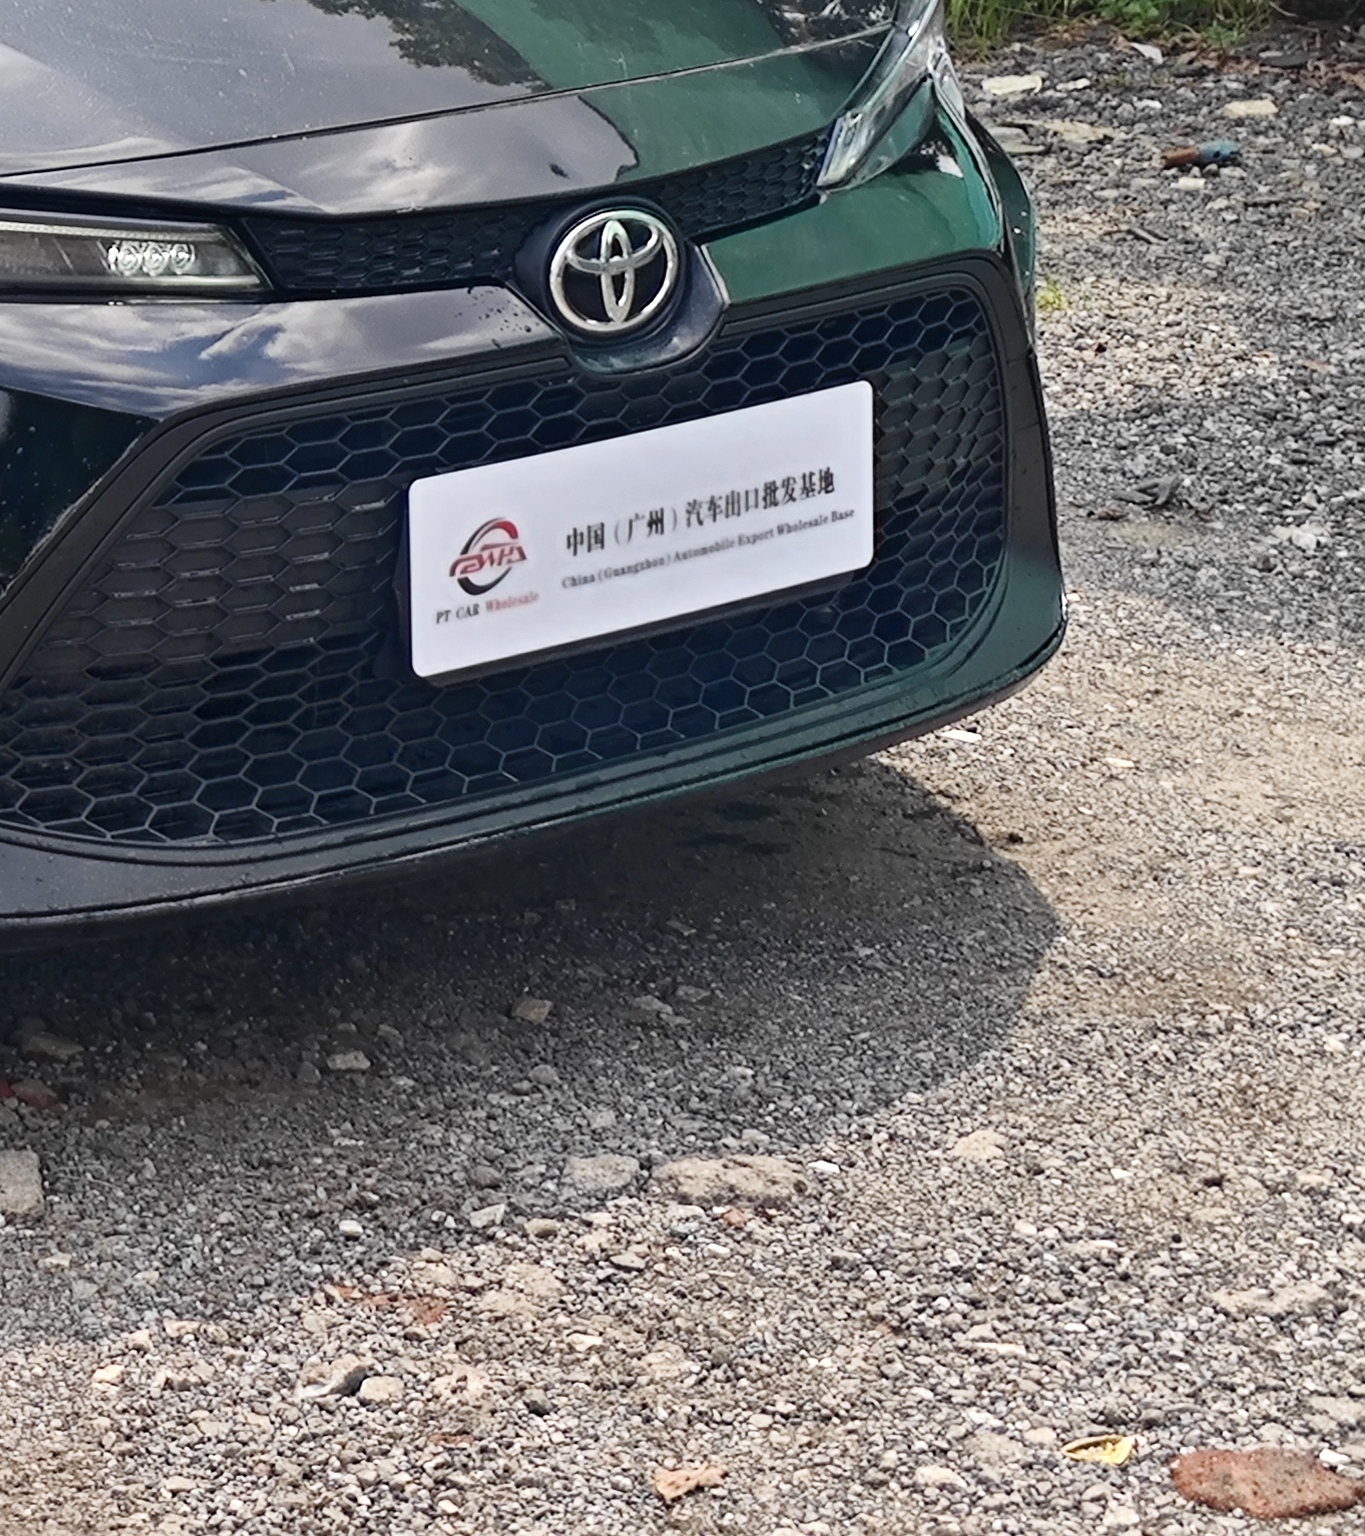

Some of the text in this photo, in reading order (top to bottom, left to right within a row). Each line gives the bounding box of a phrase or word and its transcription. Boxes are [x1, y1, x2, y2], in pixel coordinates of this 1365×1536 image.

[562, 573, 595, 589] China
[674, 538, 735, 562] Automobile
[738, 529, 774, 547] Export
[777, 514, 829, 534] Wholesale
[831, 508, 855, 523] Base
[436, 590, 540, 624] PT CAR Wholesale
